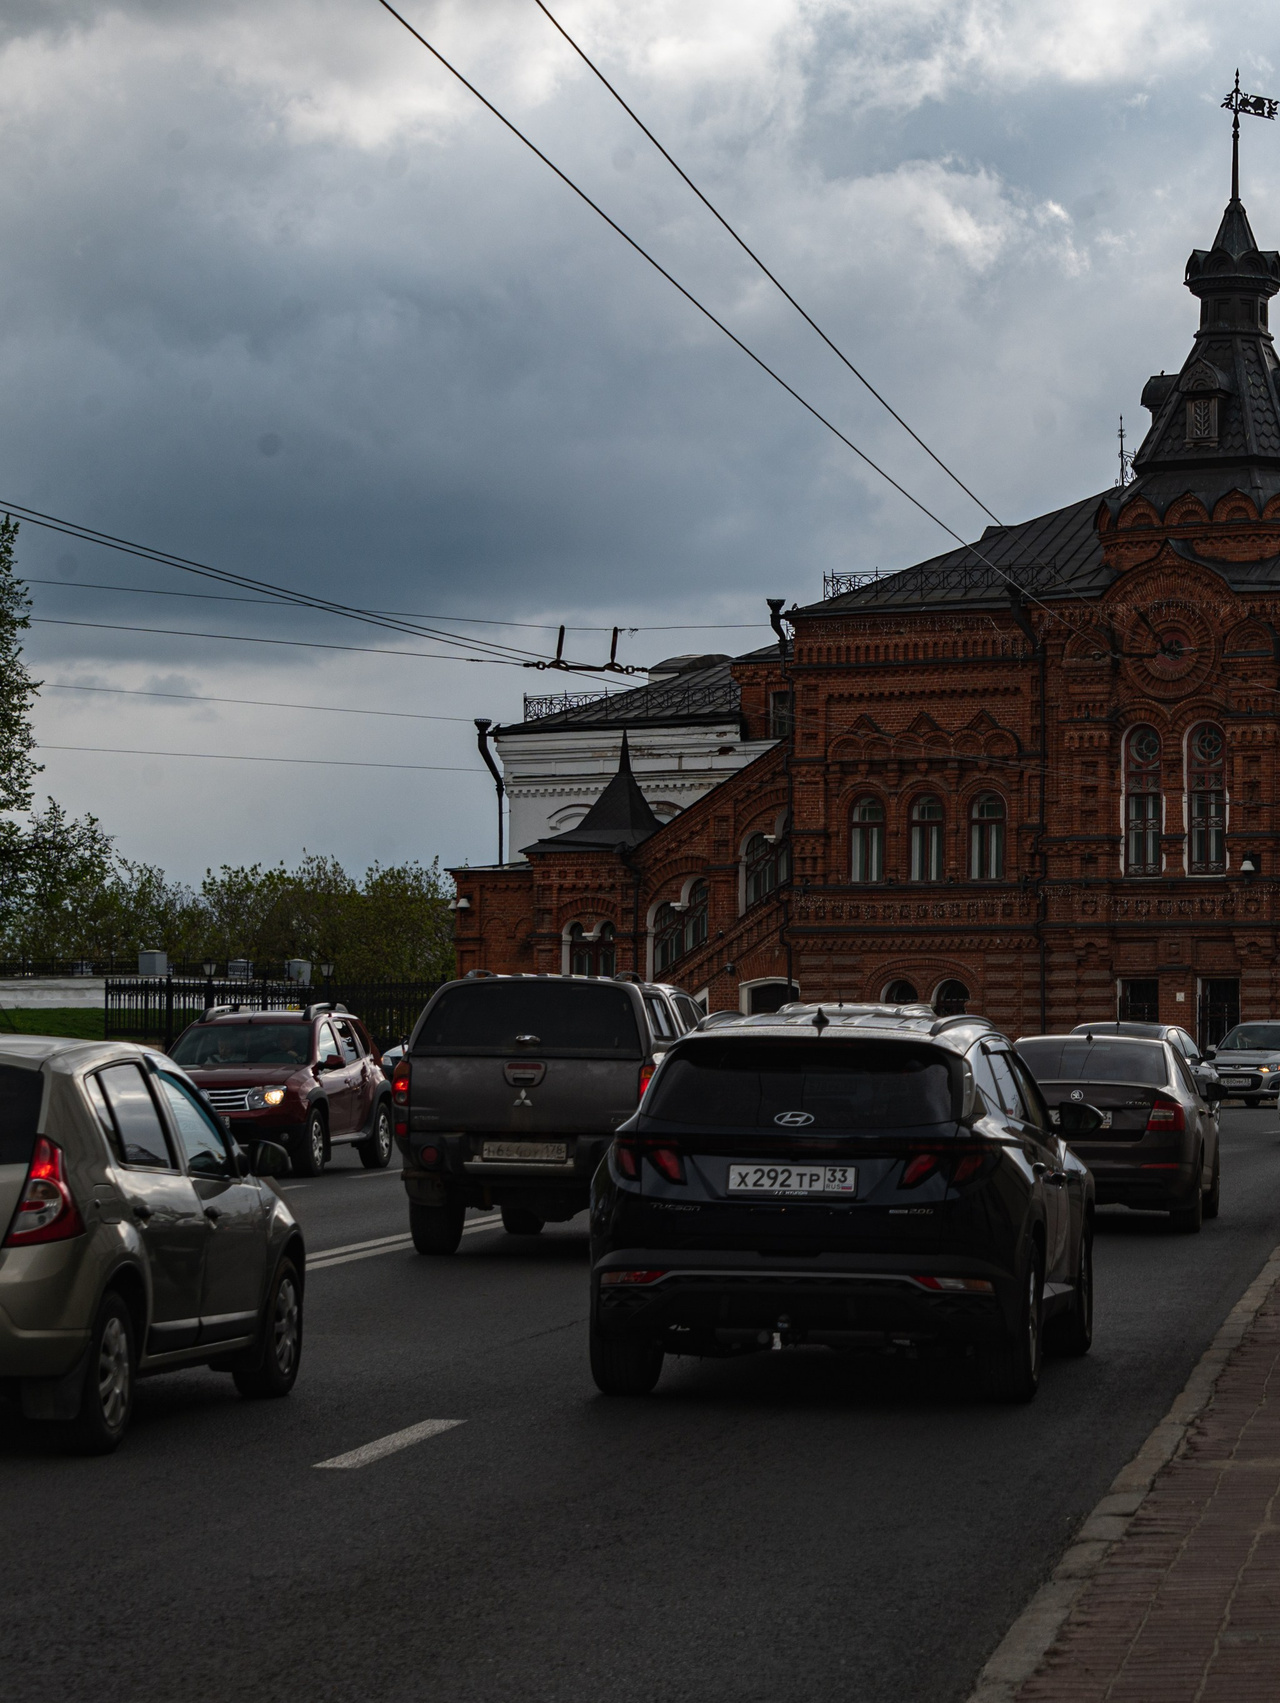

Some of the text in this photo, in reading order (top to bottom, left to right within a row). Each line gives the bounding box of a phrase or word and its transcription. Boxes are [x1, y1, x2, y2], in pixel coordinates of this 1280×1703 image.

[737, 1168, 848, 1188] Х292ТР 33
[650, 1202, 702, 1213] TUCSON
